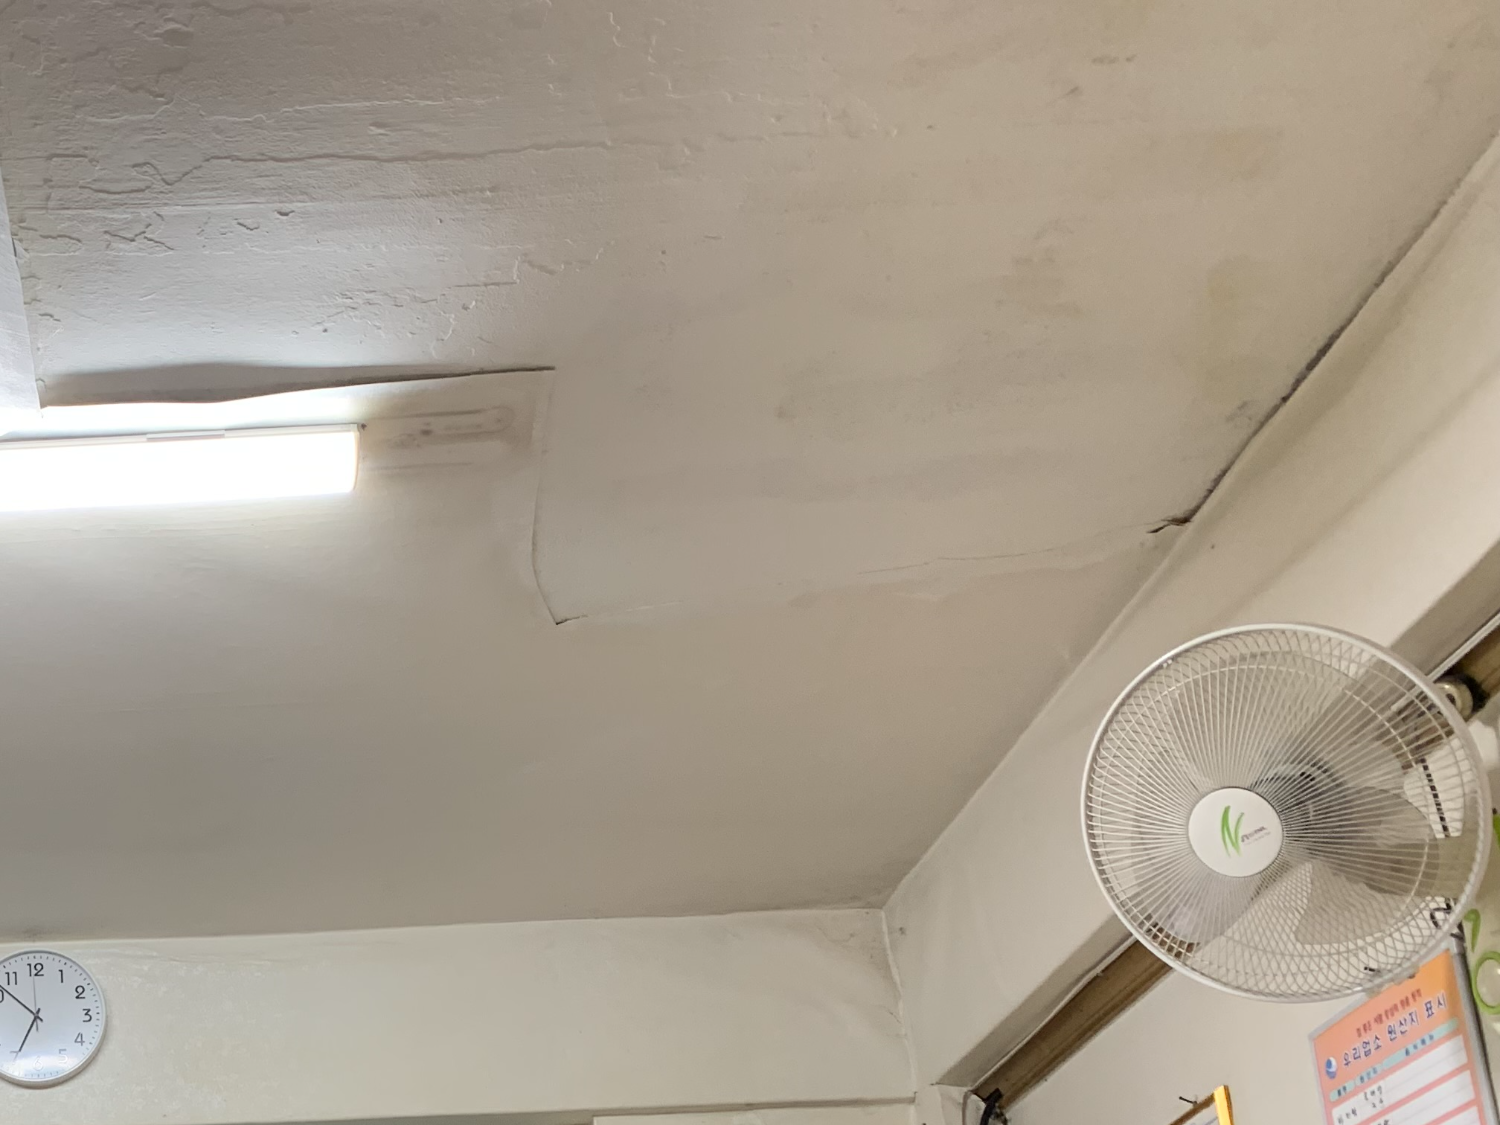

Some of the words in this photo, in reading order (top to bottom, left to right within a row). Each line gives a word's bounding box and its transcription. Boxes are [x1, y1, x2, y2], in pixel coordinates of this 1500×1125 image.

[26, 962, 44, 977] 12
[58, 969, 64, 984] 1
[5, 971, 18, 986] 11
[74, 985, 86, 999] 2
[82, 1008, 93, 1023] 3
[1343, 1033, 1383, 1068] 우리업소
[1387, 1009, 1420, 1042] 원산지
[1424, 991, 1448, 1020] 표시
[74, 1032, 85, 1047] 4
[32, 1055, 44, 1071] 6
[58, 1048, 69, 1064] 5
